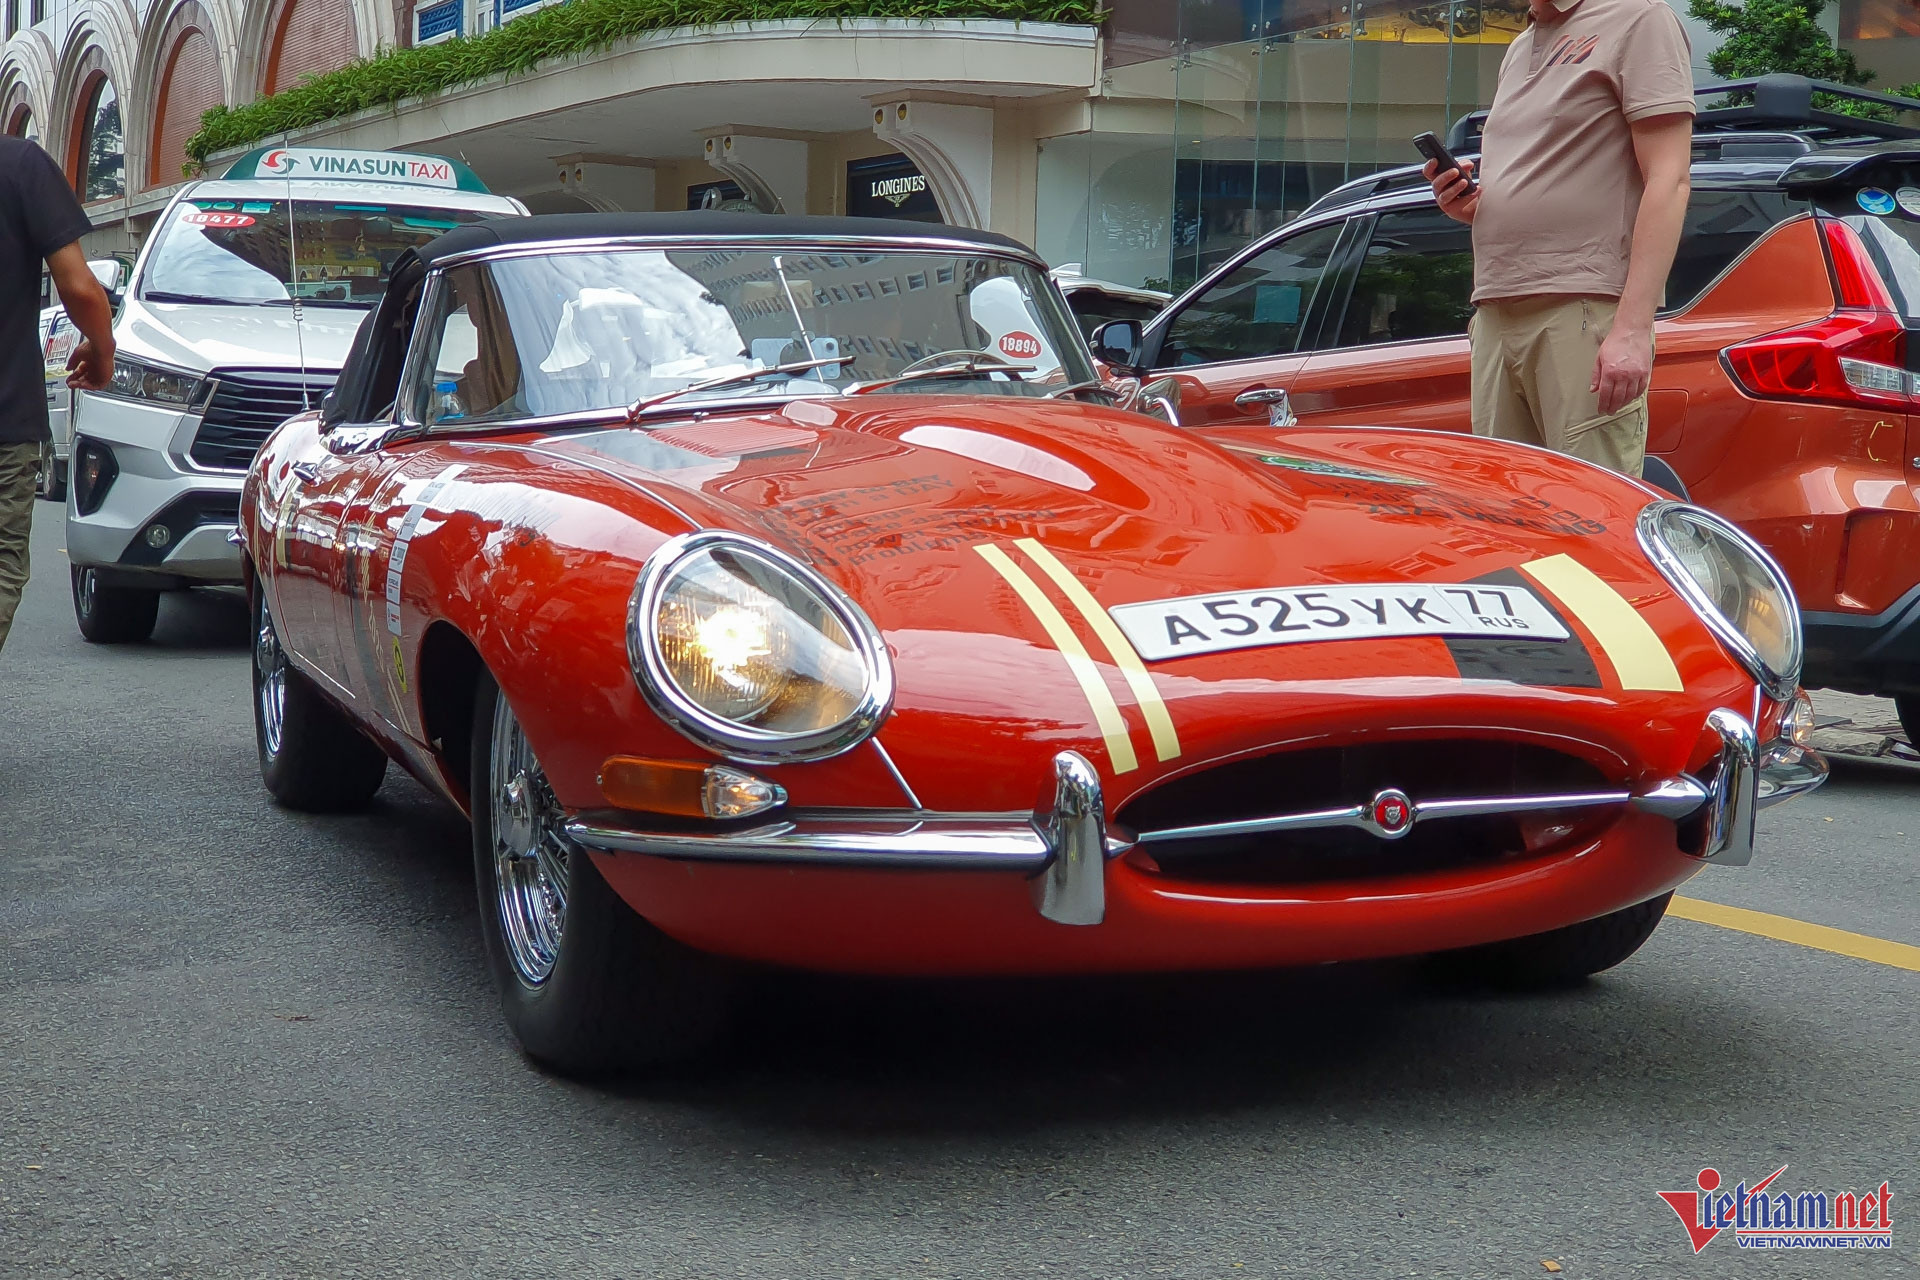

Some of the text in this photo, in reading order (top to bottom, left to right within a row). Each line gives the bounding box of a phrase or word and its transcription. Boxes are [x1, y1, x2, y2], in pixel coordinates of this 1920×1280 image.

[871, 174, 926, 198] LONGINES
[187, 214, 249, 225] 18477
[1002, 336, 1038, 355] 18894
[895, 479, 954, 496] DAY
[835, 529, 925, 556] power
[1444, 589, 1515, 617] 77
[1479, 615, 1530, 630] RUS
